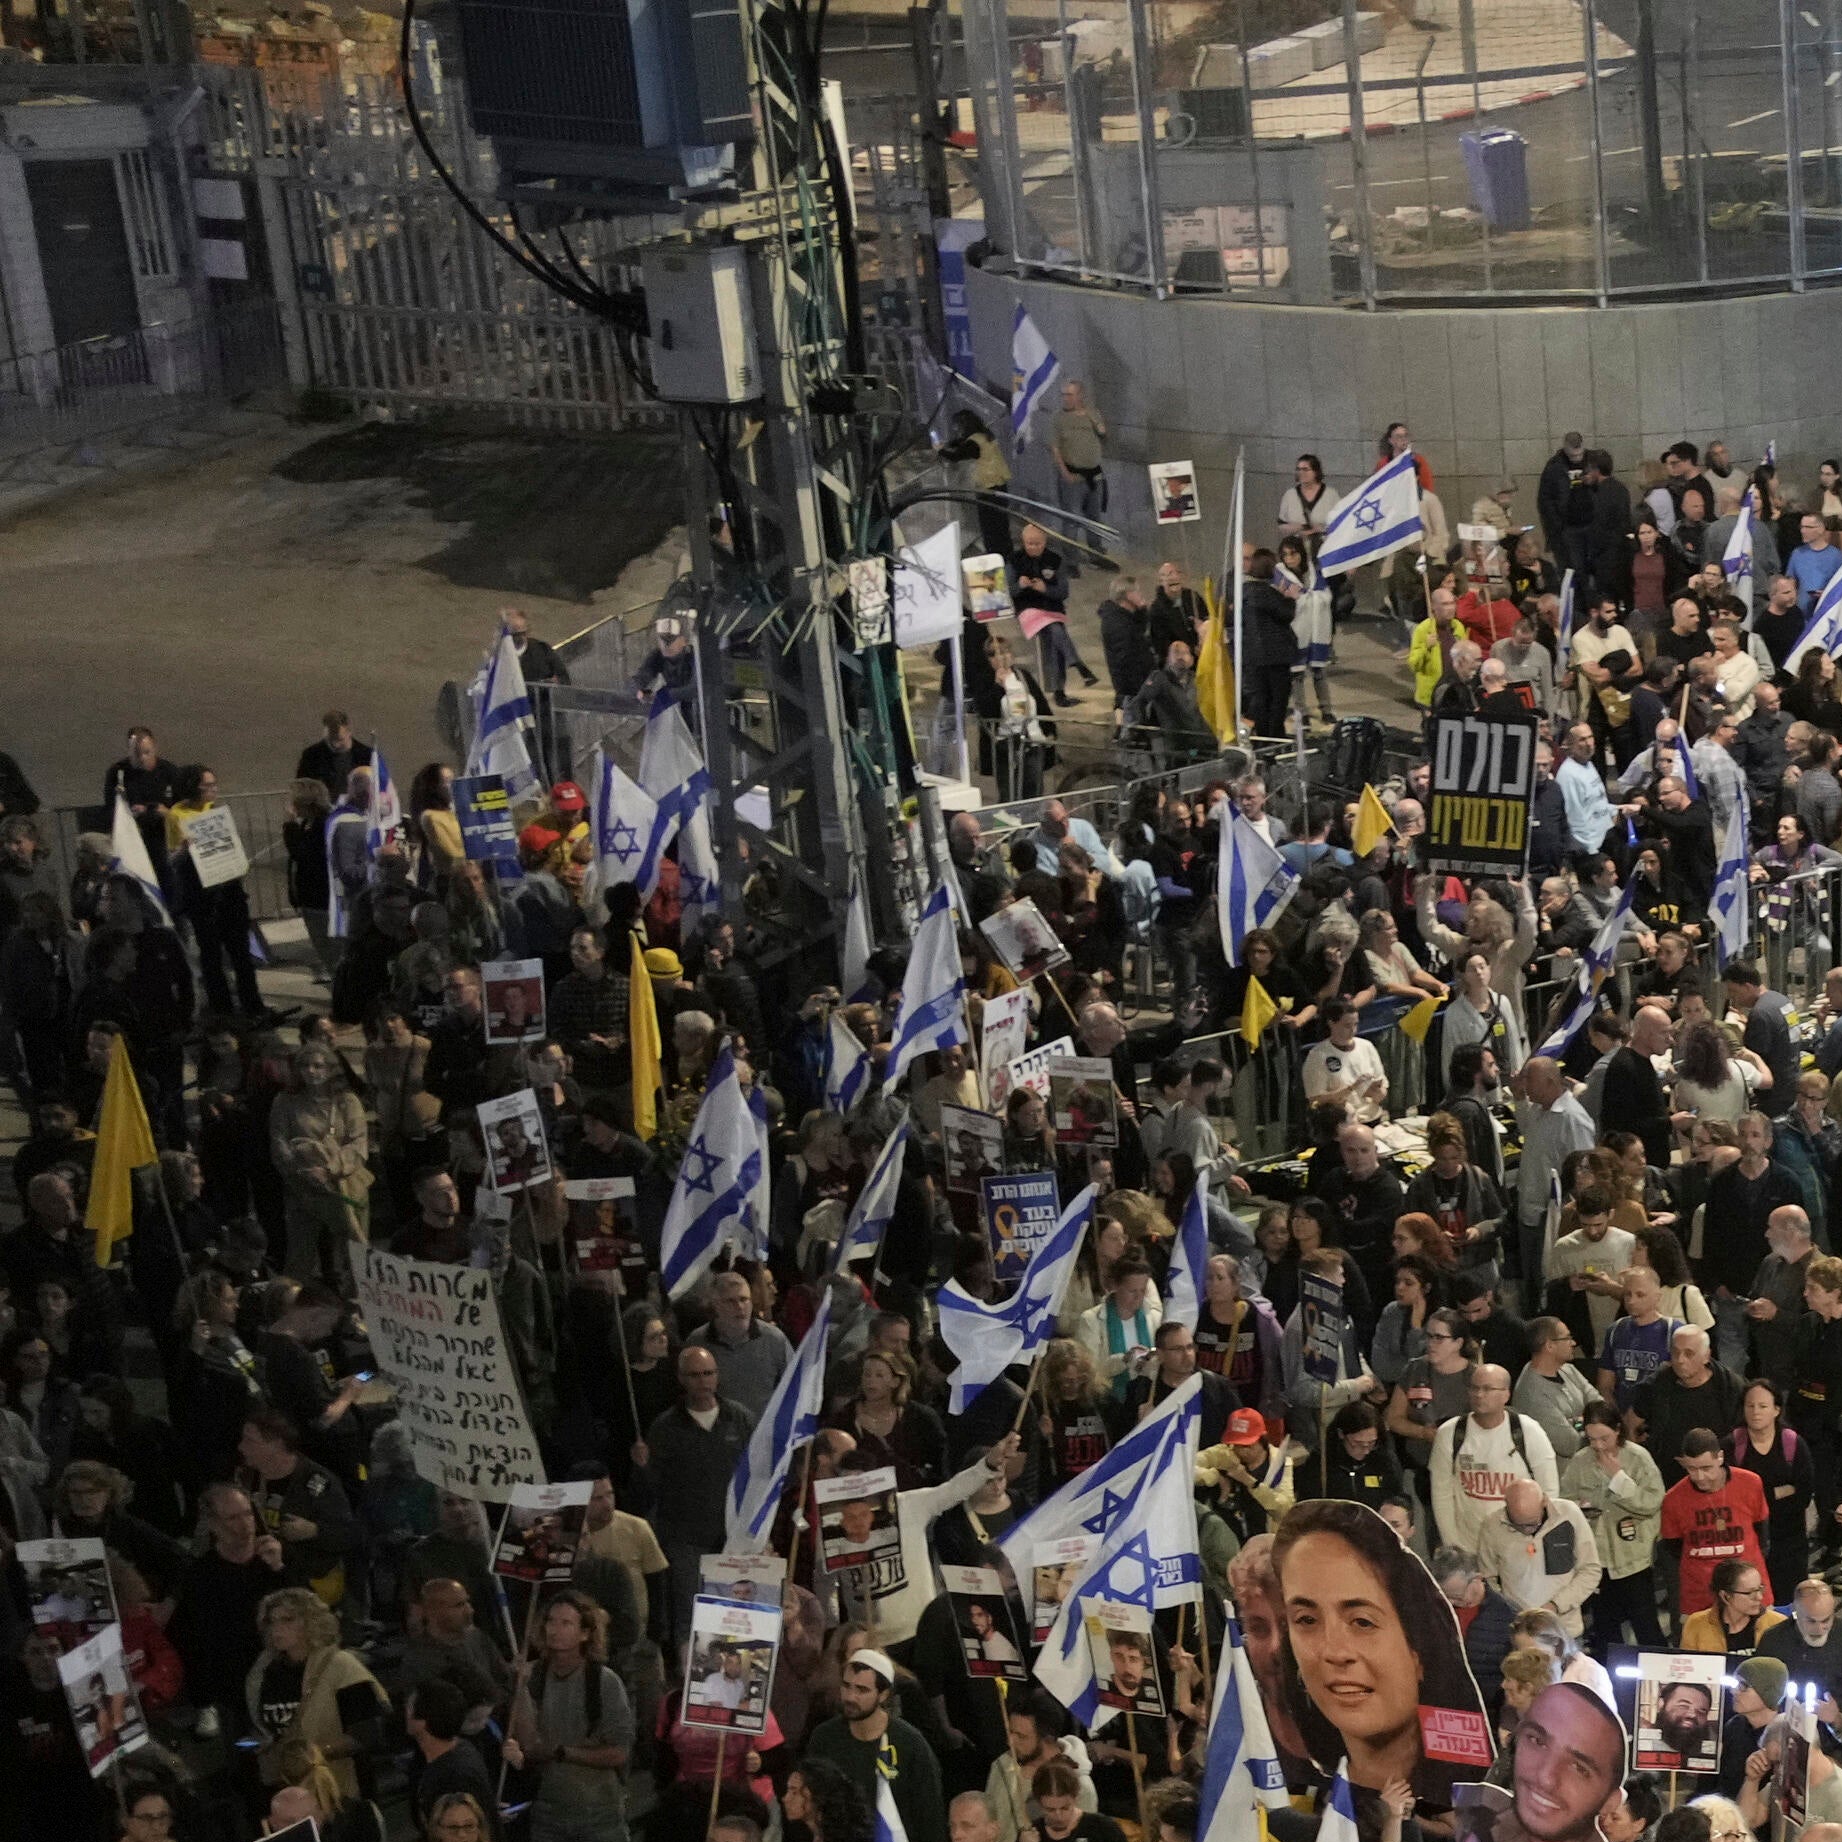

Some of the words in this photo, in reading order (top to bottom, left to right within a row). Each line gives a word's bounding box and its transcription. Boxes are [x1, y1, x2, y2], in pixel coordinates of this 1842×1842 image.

[1433, 717, 1532, 793] כולם
[1431, 796, 1526, 850] עכשיו!
[1436, 1710, 1483, 1733] עדיין
